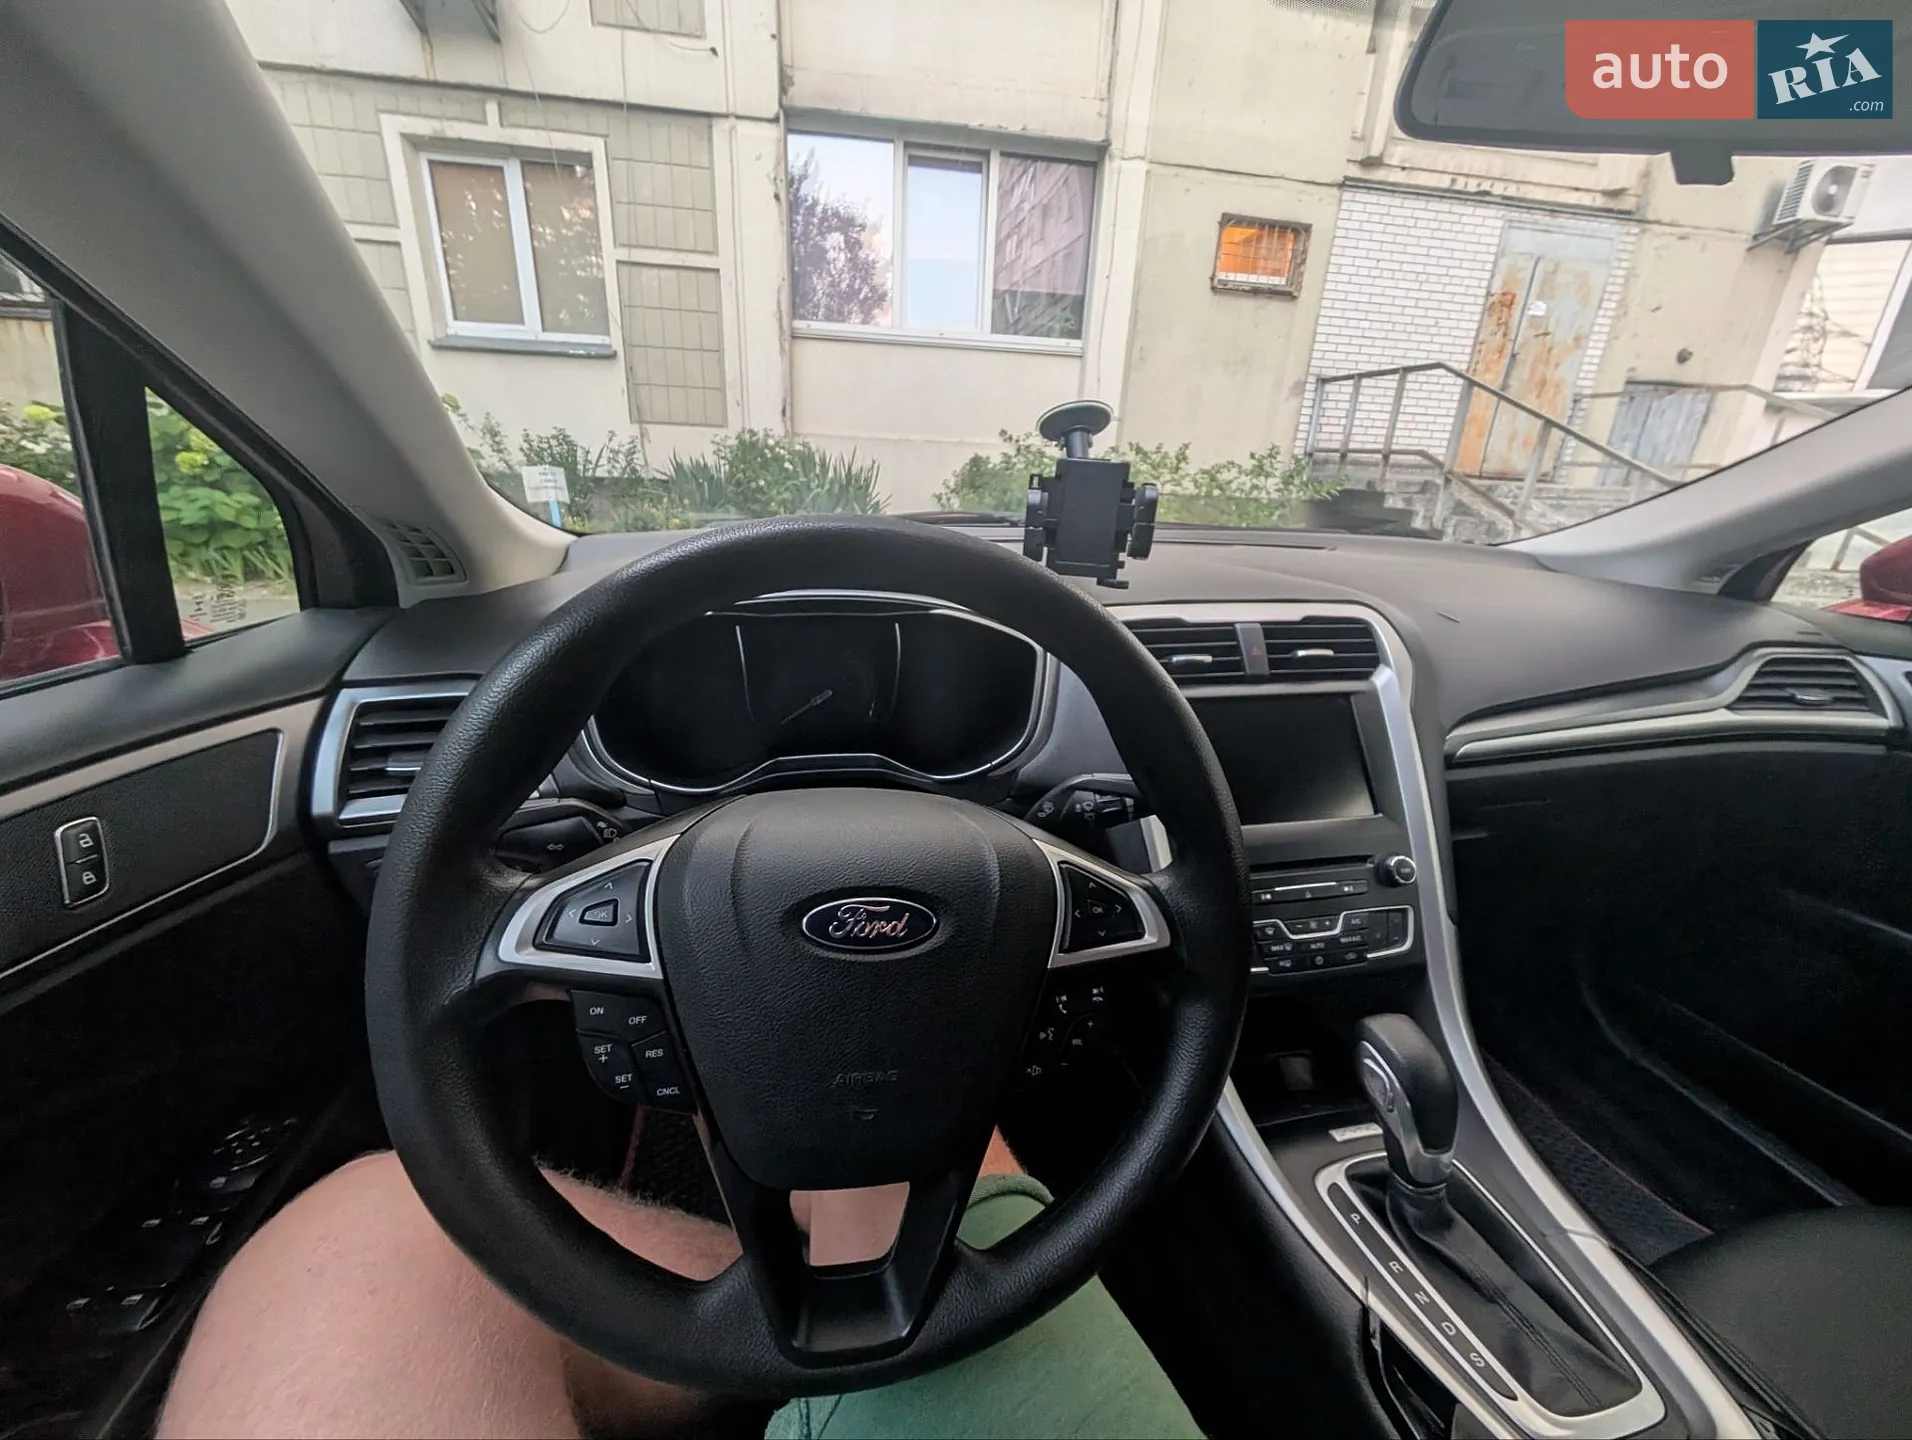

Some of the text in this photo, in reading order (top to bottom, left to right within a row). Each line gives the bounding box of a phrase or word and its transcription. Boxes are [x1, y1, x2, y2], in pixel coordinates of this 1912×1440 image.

[829, 904, 910, 939] Ford
[590, 1006, 604, 1015] ON
[628, 1015, 648, 1025] OFF
[594, 1044, 612, 1055] SET
[645, 1049, 664, 1059] RES
[615, 1073, 633, 1084] SET
[656, 1086, 680, 1096] CNCL
[1388, 1260, 1404, 1273] R
[1414, 1290, 1431, 1305] N
[1441, 1321, 1457, 1336] D
[1469, 1352, 1486, 1368] S
